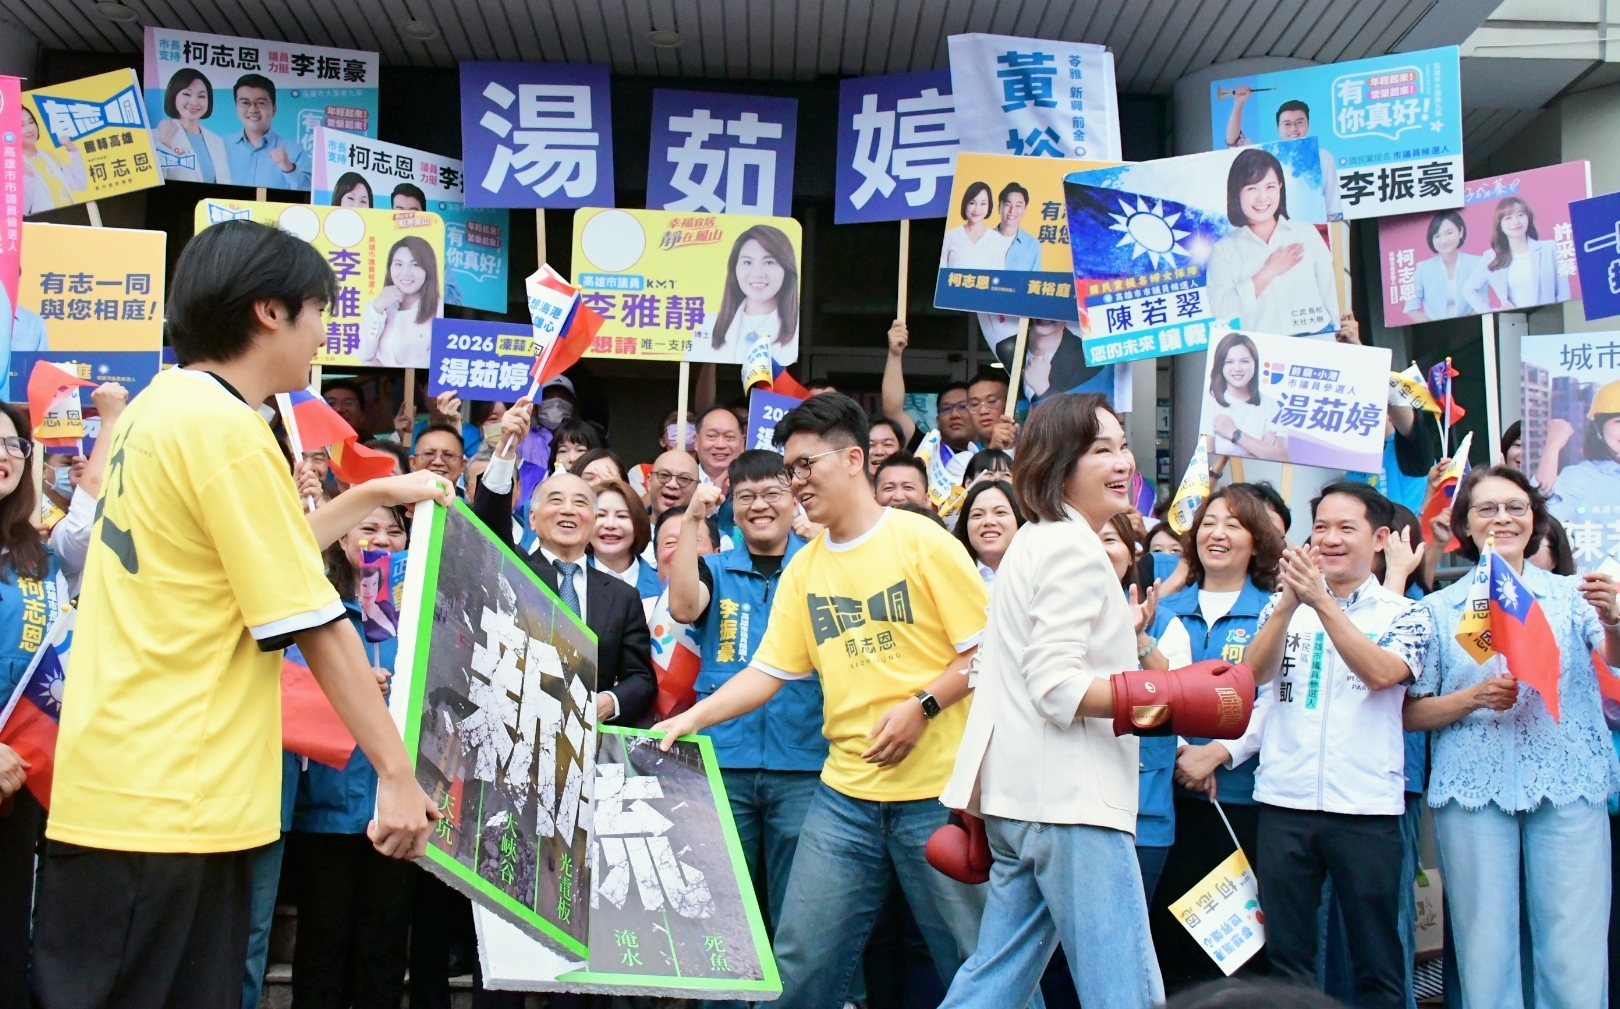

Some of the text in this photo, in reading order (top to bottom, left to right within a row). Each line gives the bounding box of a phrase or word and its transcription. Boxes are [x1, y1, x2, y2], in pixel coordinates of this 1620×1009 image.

[159, 39, 181, 51] 市長
[159, 50, 181, 62] 支持
[183, 41, 262, 71] 柯志恩
[268, 51, 290, 64] 議員
[268, 62, 290, 75] 力挺
[290, 53, 367, 83] 李振豪
[1068, 54, 1087, 142] 苓雅 新興 前金
[1337, 79, 1365, 107] 有
[1337, 98, 1431, 134] 你真好!
[328, 140, 346, 153] 市長
[479, 81, 599, 199] 湯
[849, 87, 961, 211] 婷
[89, 152, 152, 184] 柯志恩
[328, 151, 346, 164] 支持
[348, 143, 414, 181] 柯志恩
[664, 109, 783, 216] 茹
[439, 166, 464, 194] 李
[1339, 161, 1454, 206] 李振豪
[3, 146, 18, 253] 高雄市市議員候選人
[447, 226, 465, 248] 有
[446, 247, 502, 275] 你真好!
[1397, 248, 1417, 302] 柯志恩
[39, 272, 151, 295] 有志一同
[582, 275, 641, 290] 高雄市議員
[947, 271, 990, 291] 柯志恩
[1026, 279, 1071, 299] 黃裕庭
[39, 298, 157, 321] 與您相庭!
[327, 248, 361, 356] 李雅靜
[528, 297, 563, 320] 想海港
[579, 291, 706, 331] 李雅靜
[1106, 290, 1203, 333] 陳若翠
[531, 313, 555, 333] 雄心
[446, 333, 494, 352] 2026
[590, 336, 693, 355] 懇請 唯一支持
[1090, 334, 1155, 363] 您的未來
[437, 357, 530, 392] 湯茹婷
[1288, 378, 1356, 395] 市議員參選人
[1272, 392, 1383, 437] 湯茹婷
[20, 577, 46, 652] 柯志恩
[716, 598, 739, 663] 李振豪
[845, 630, 897, 659] 柯志恩
[1221, 643, 1246, 665] 柯
[1306, 632, 1325, 708] 高雄市議員參選人
[438, 791, 455, 847] 天坑
[499, 812, 517, 886] 大峽谷
[556, 852, 572, 925] 光電板
[1179, 876, 1238, 929] 柯志恩
[614, 928, 643, 966] 淹水
[704, 934, 731, 972] 死魚
